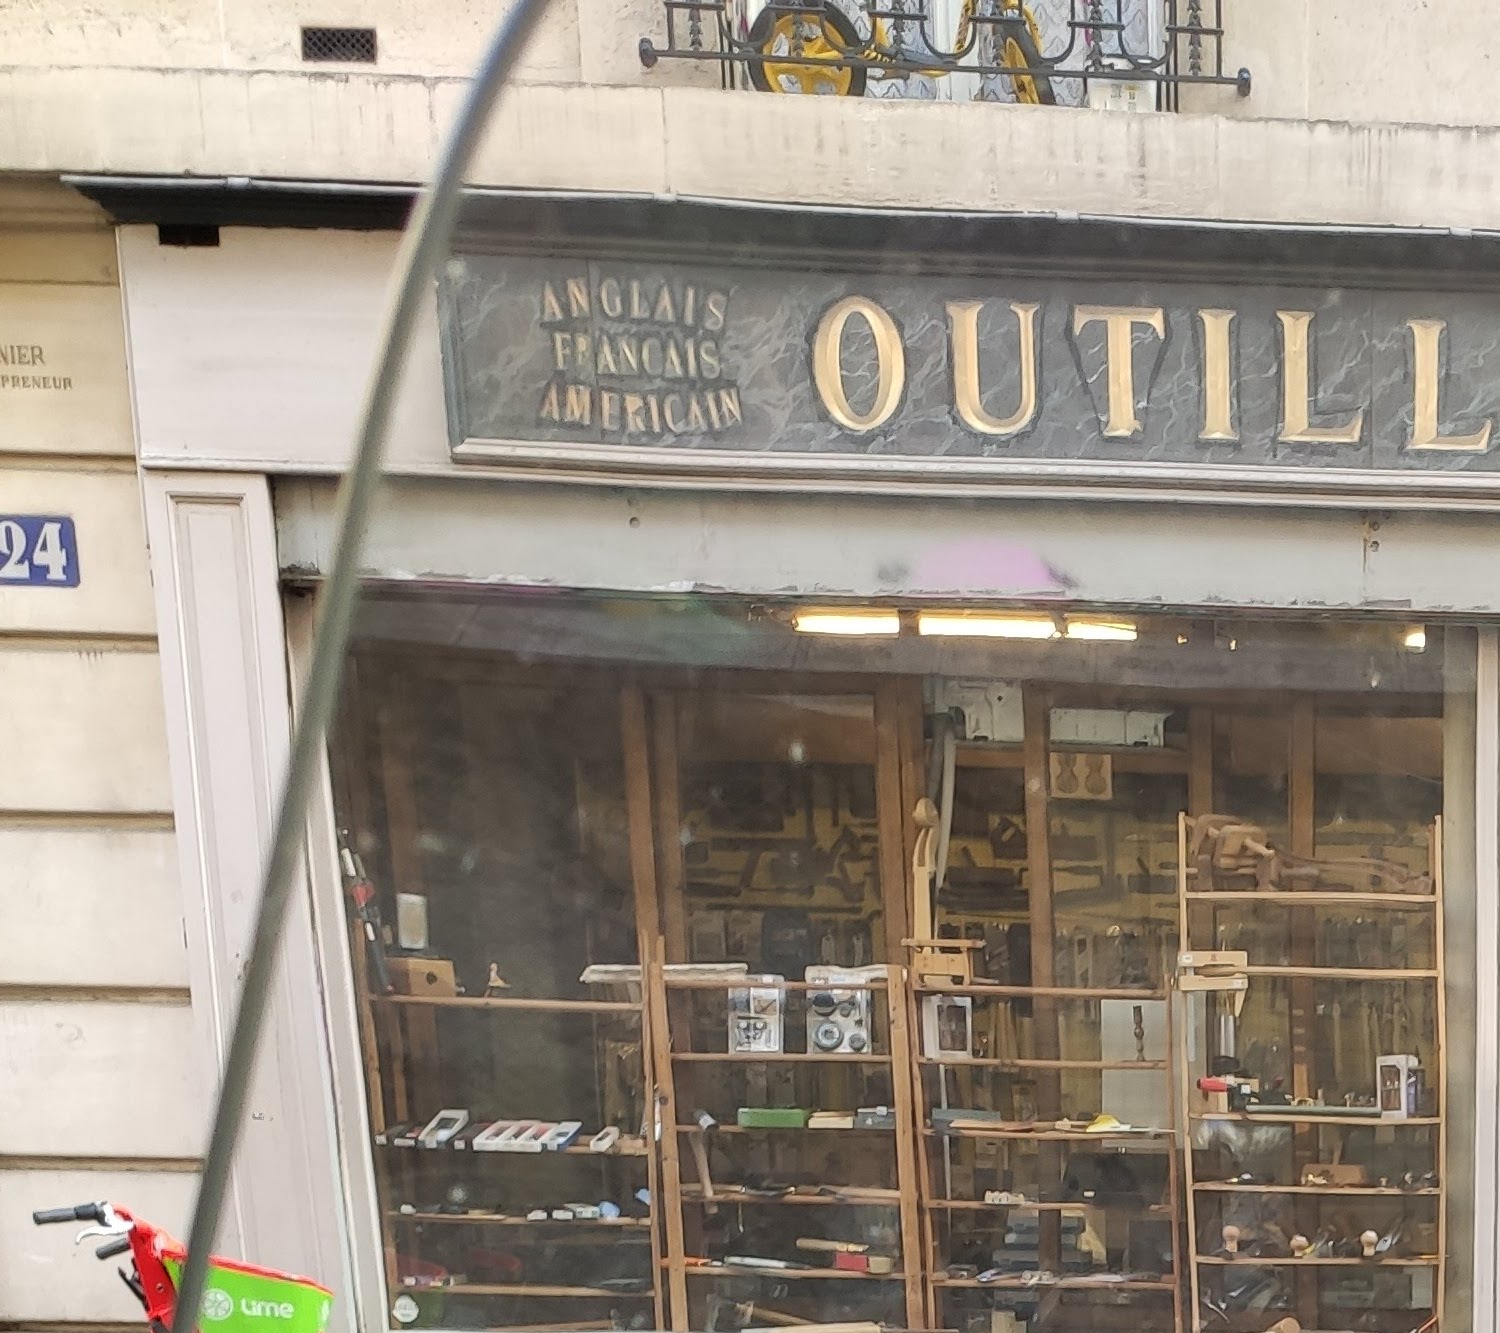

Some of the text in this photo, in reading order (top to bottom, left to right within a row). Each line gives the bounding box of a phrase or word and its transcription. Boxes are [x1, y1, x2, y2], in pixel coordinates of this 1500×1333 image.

[541, 276, 728, 331] ANGLAIS
[539, 383, 743, 434] AMERICAIN
[0, 520, 67, 581] 24
